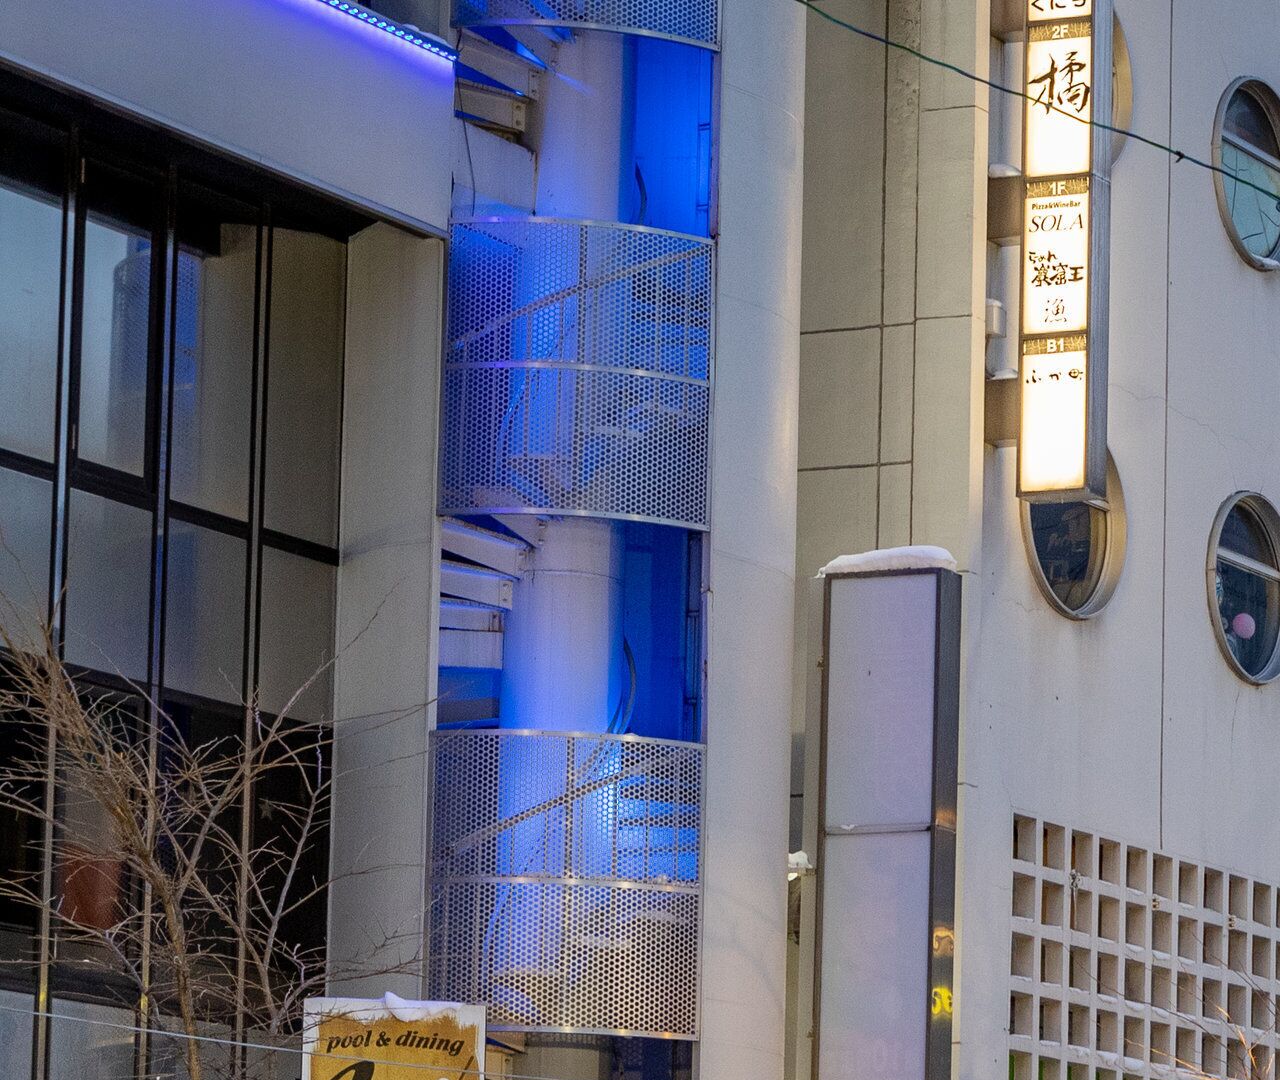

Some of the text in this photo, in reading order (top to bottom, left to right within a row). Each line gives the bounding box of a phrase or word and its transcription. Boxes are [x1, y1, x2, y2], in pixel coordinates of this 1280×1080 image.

[1052, 25, 1069, 39] 2F
[1027, 51, 1090, 114] 橘
[1050, 182, 1067, 195] 1F
[1029, 213, 1084, 233] SOLA
[1046, 338, 1064, 353] B1
[327, 1031, 465, 1056] pool & dining
